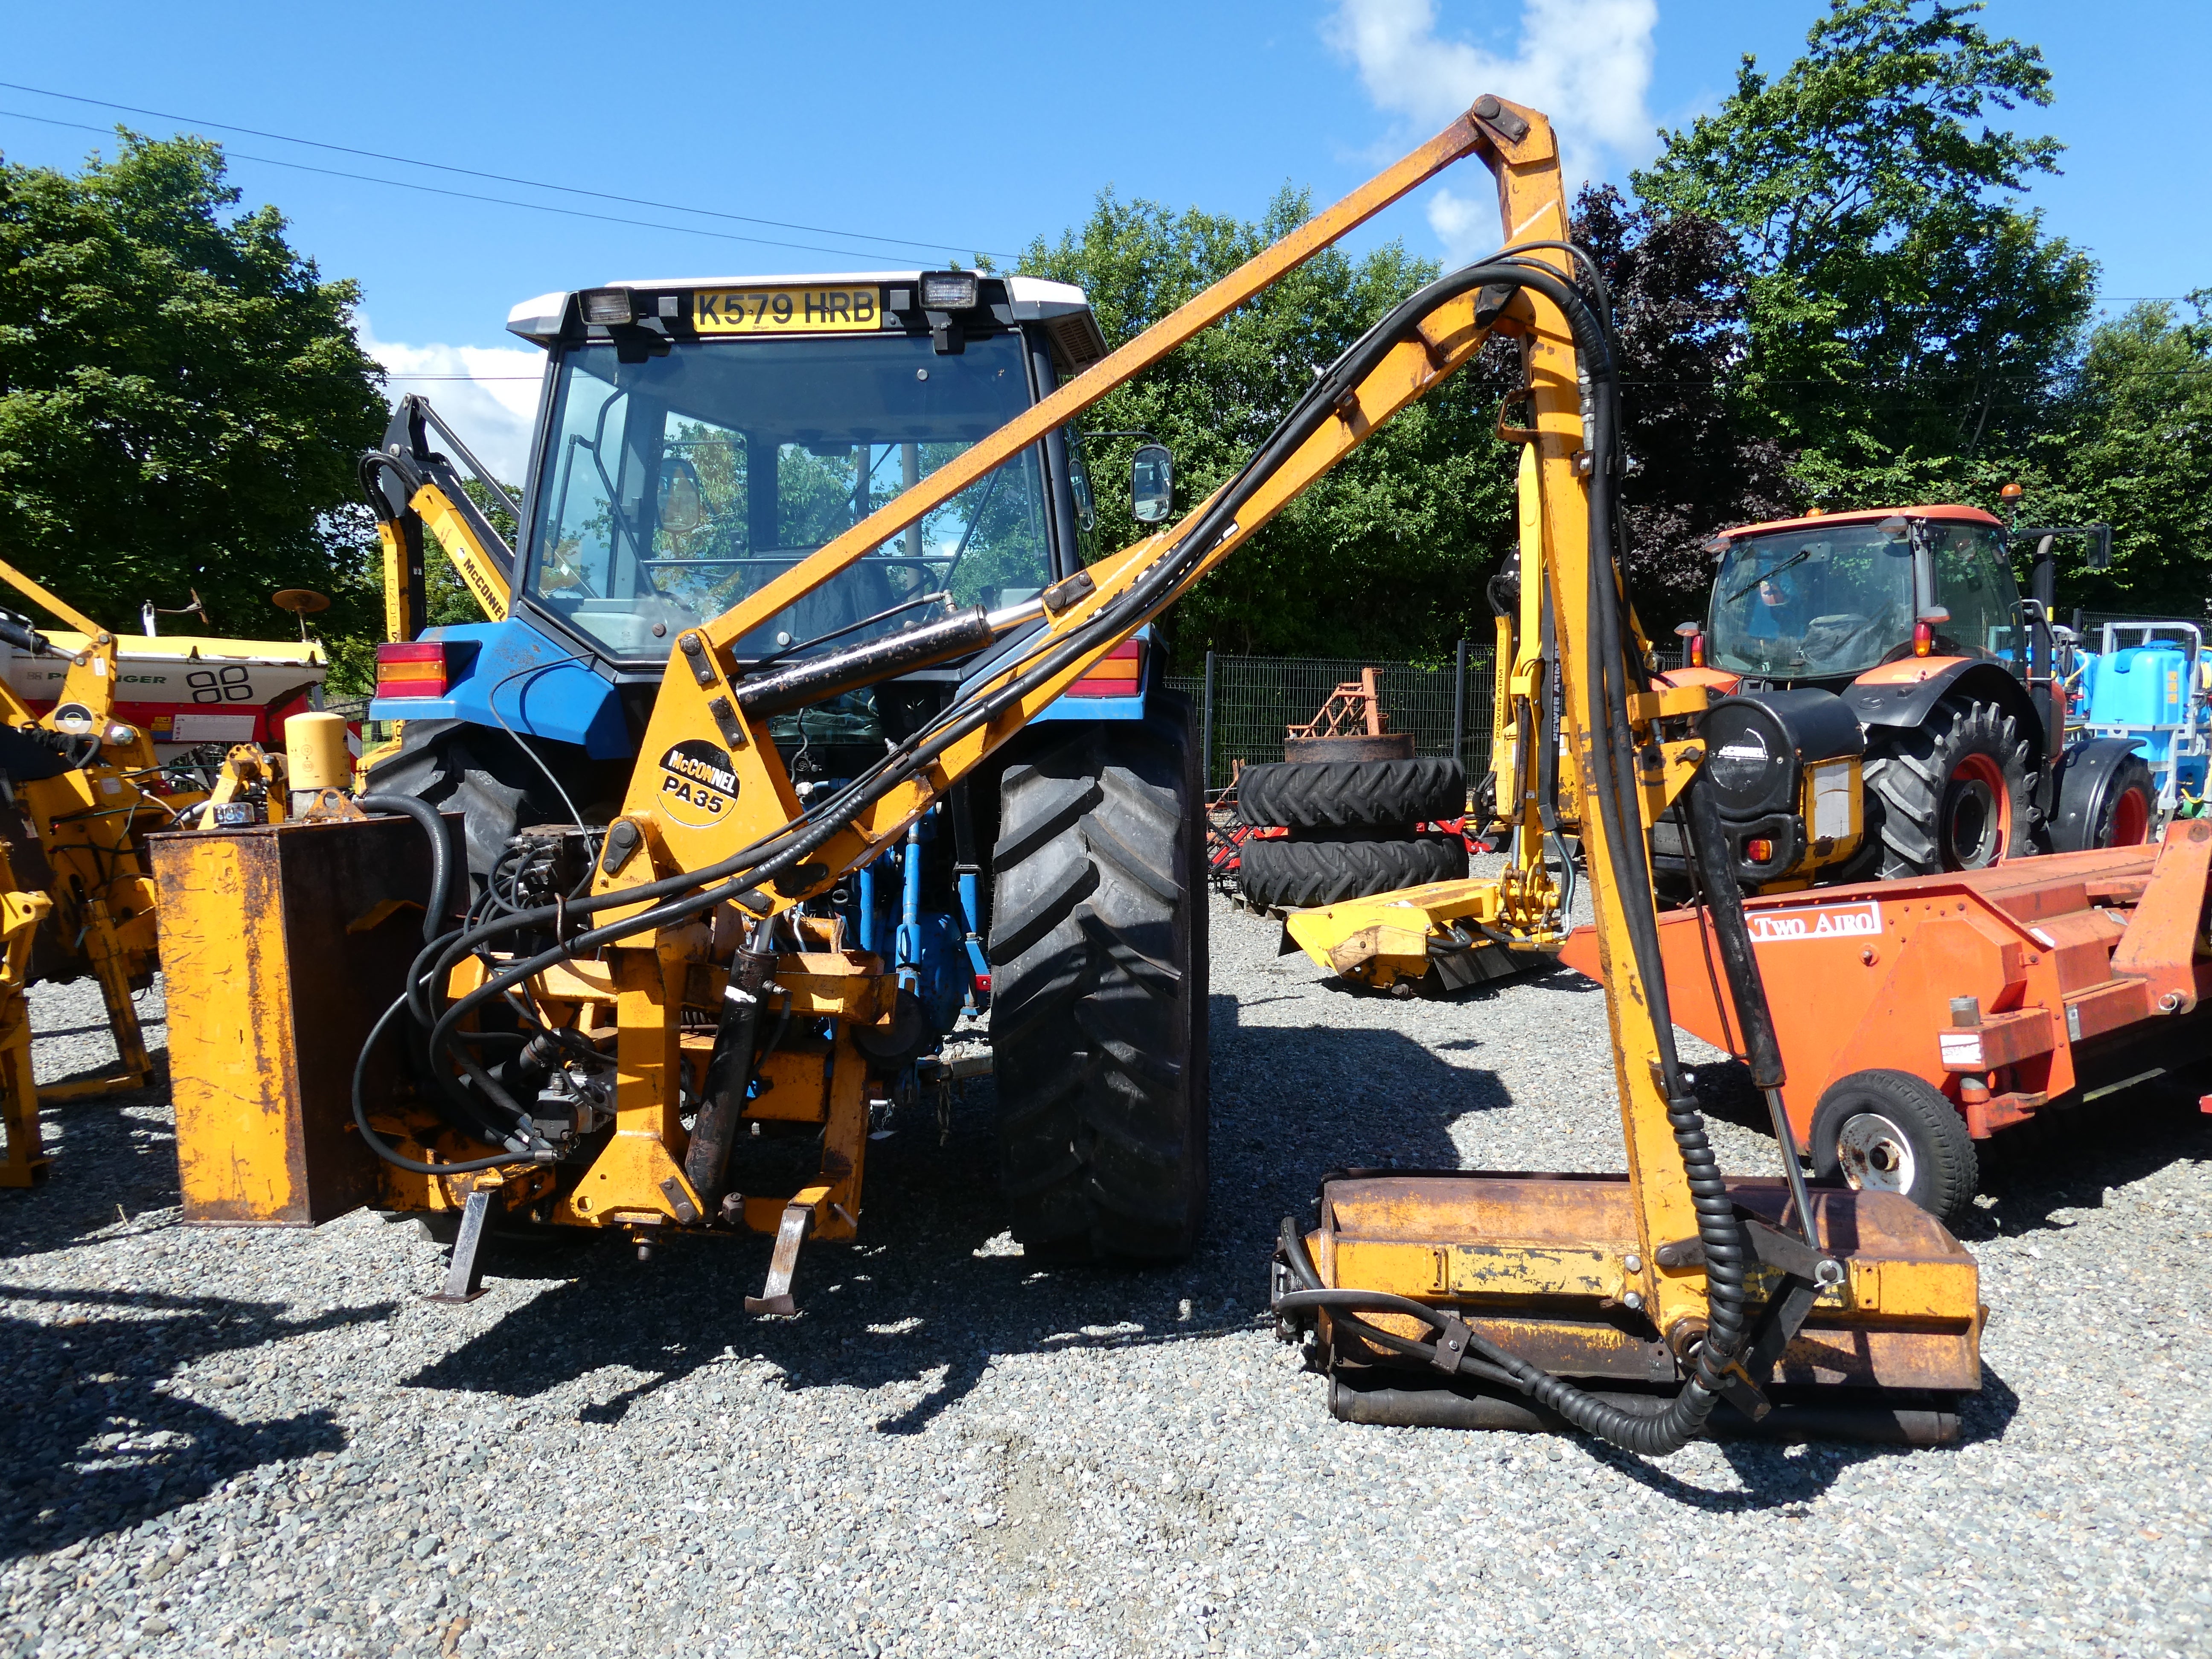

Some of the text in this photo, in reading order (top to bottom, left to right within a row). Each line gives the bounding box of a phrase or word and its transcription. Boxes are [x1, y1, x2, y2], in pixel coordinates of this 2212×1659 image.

[699, 291, 875, 326] K579 HRB
[668, 750, 736, 794] McCONNEL
